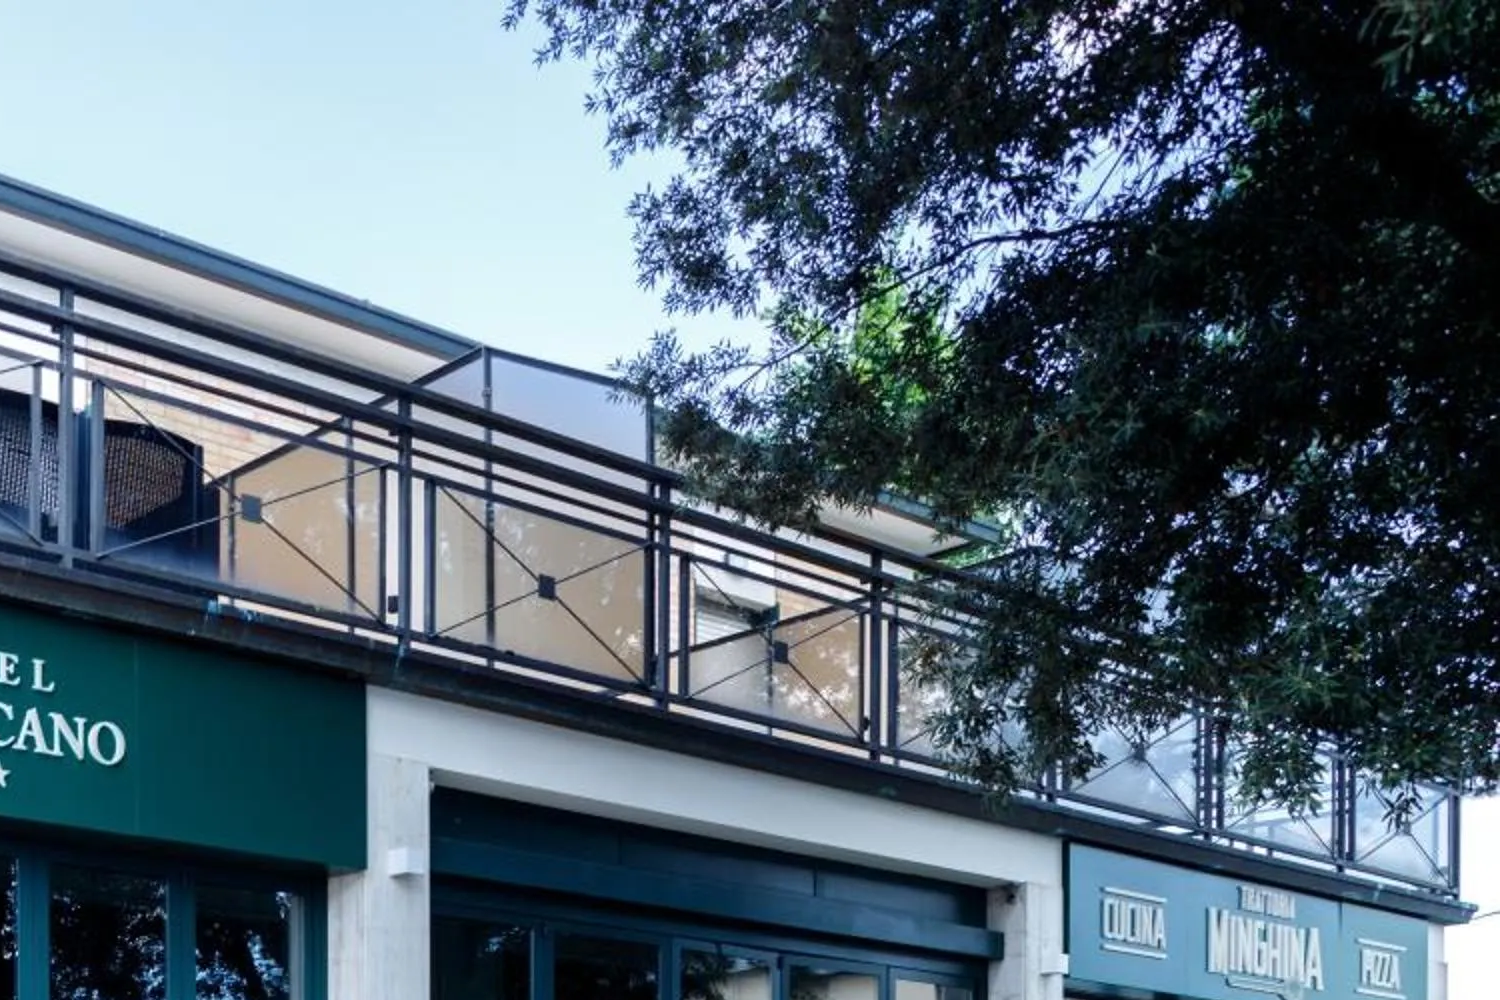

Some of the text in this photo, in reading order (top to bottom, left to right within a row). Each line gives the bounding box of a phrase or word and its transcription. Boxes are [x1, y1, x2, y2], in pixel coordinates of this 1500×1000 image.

[1103, 898, 1167, 950] CUCINA
[1208, 906, 1324, 991] MINGHINA
[1362, 949, 1400, 991] PIZZA
